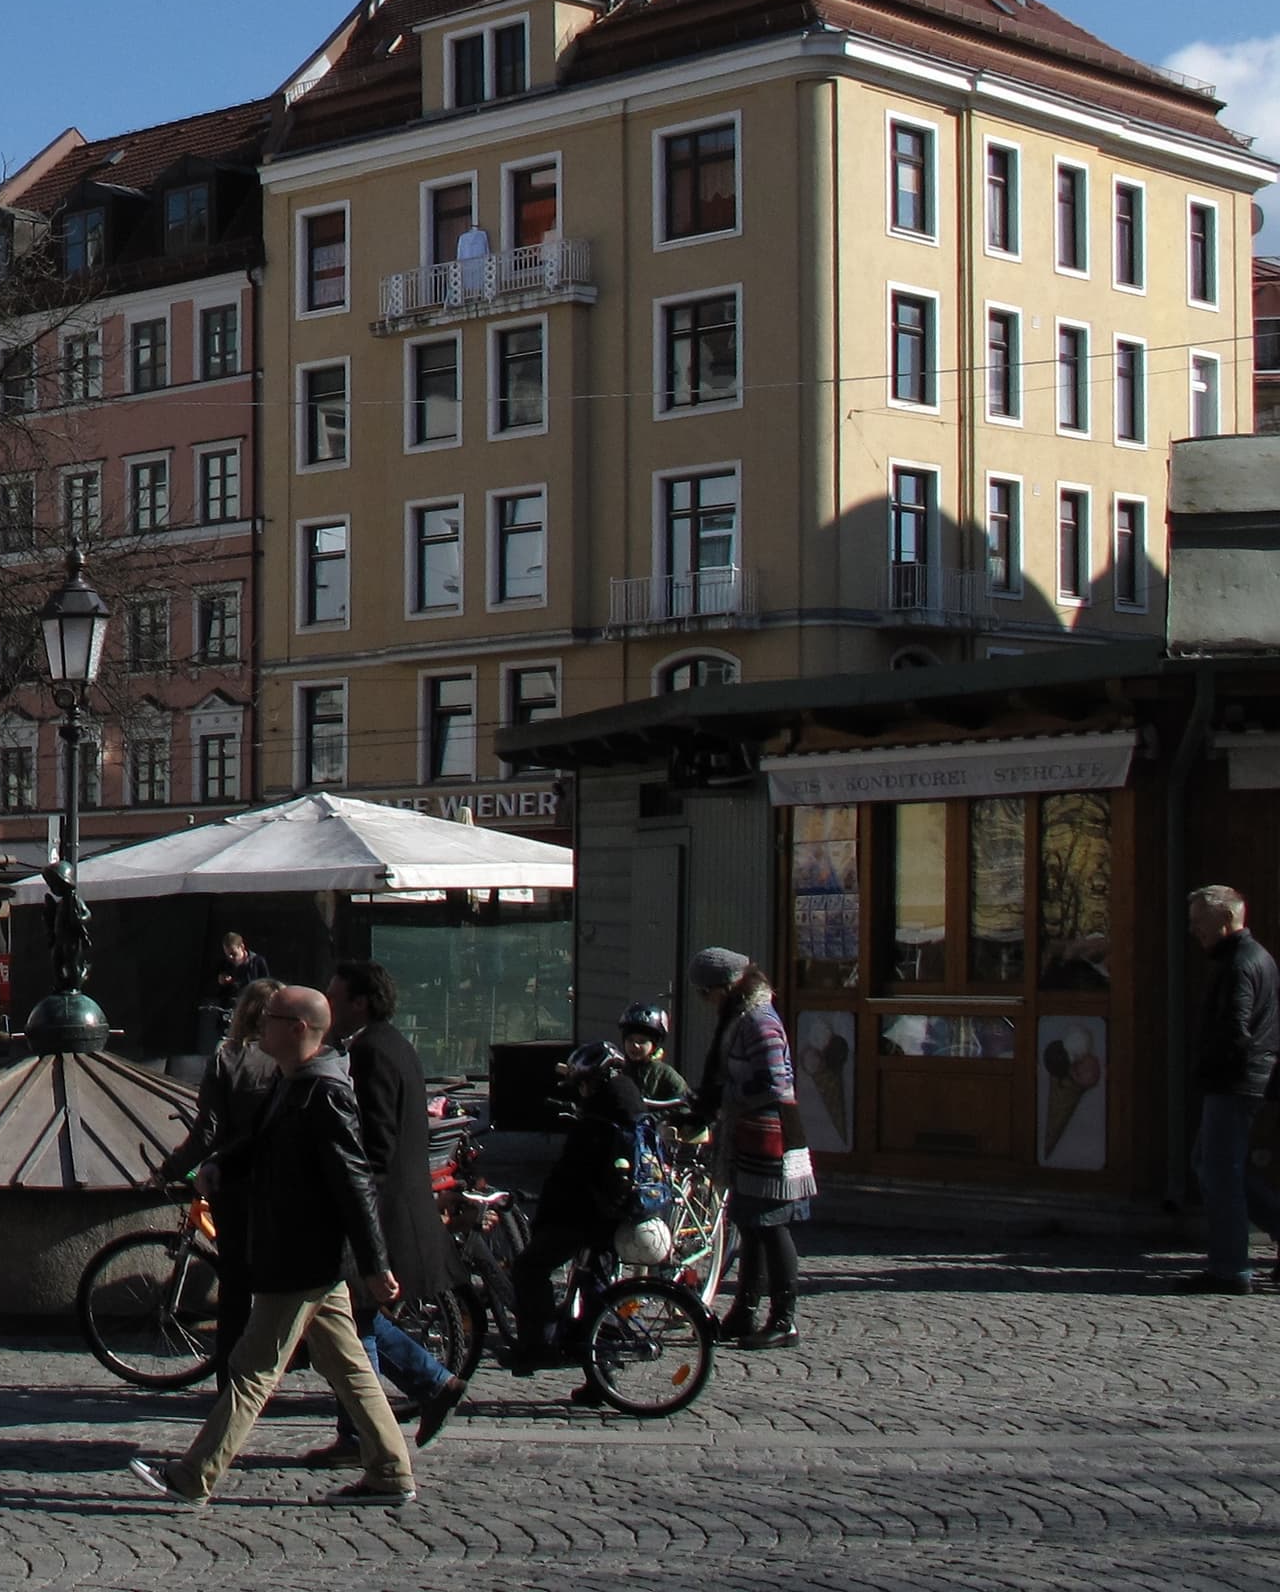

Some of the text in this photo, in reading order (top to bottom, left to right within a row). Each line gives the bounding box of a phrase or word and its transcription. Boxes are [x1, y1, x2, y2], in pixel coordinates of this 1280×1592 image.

[792, 779, 822, 794] EIS
[845, 770, 967, 792] KONDITOREI
[438, 791, 558, 819] WIENER
